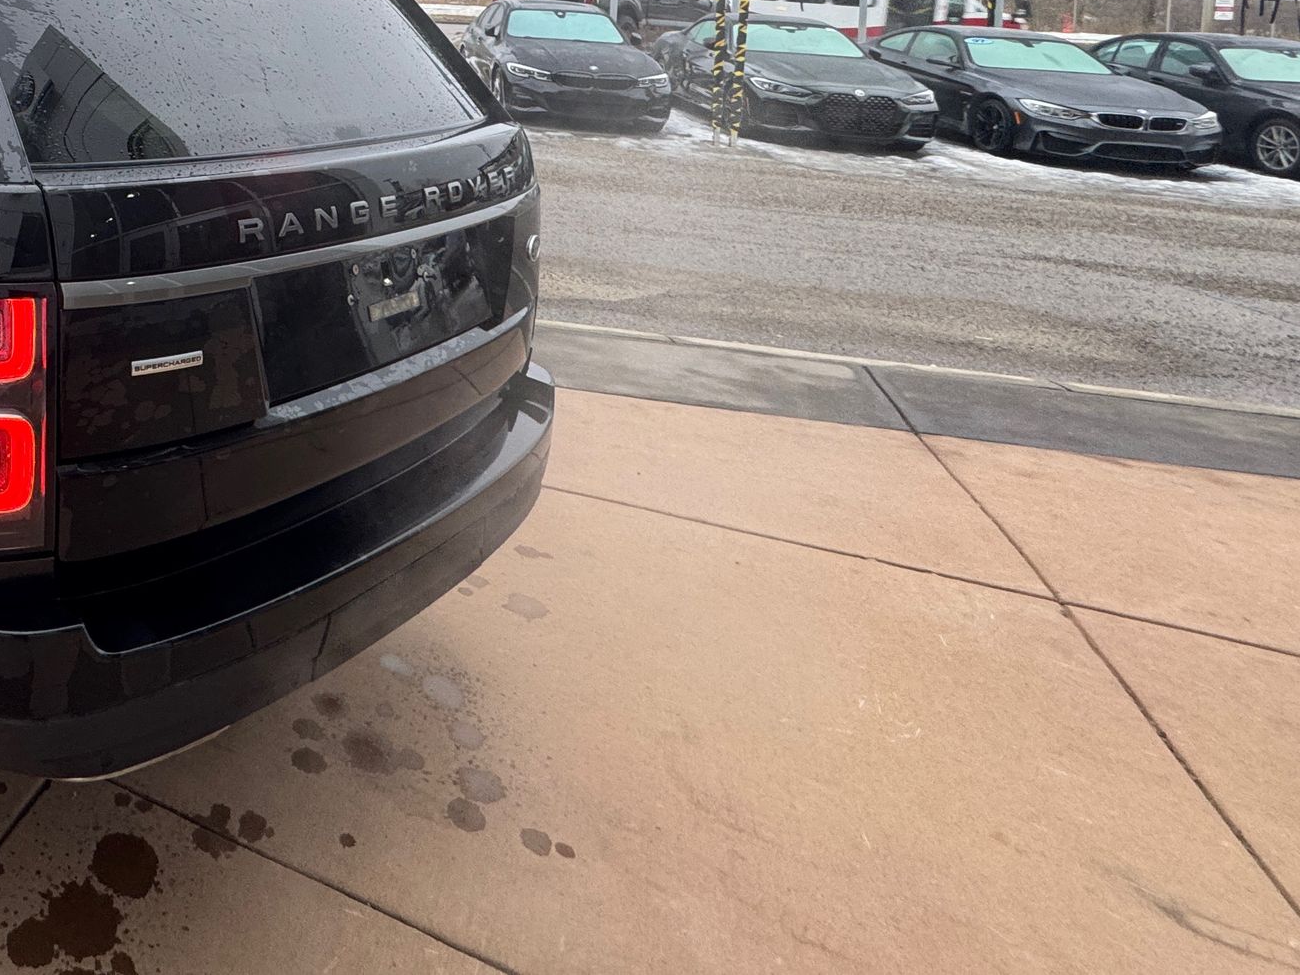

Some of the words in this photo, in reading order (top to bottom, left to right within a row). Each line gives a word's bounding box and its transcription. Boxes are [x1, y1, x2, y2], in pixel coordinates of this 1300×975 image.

[238, 195, 399, 243] RANGE
[423, 166, 516, 211] ROVER
[133, 355, 202, 372] SUPERCHARGED
